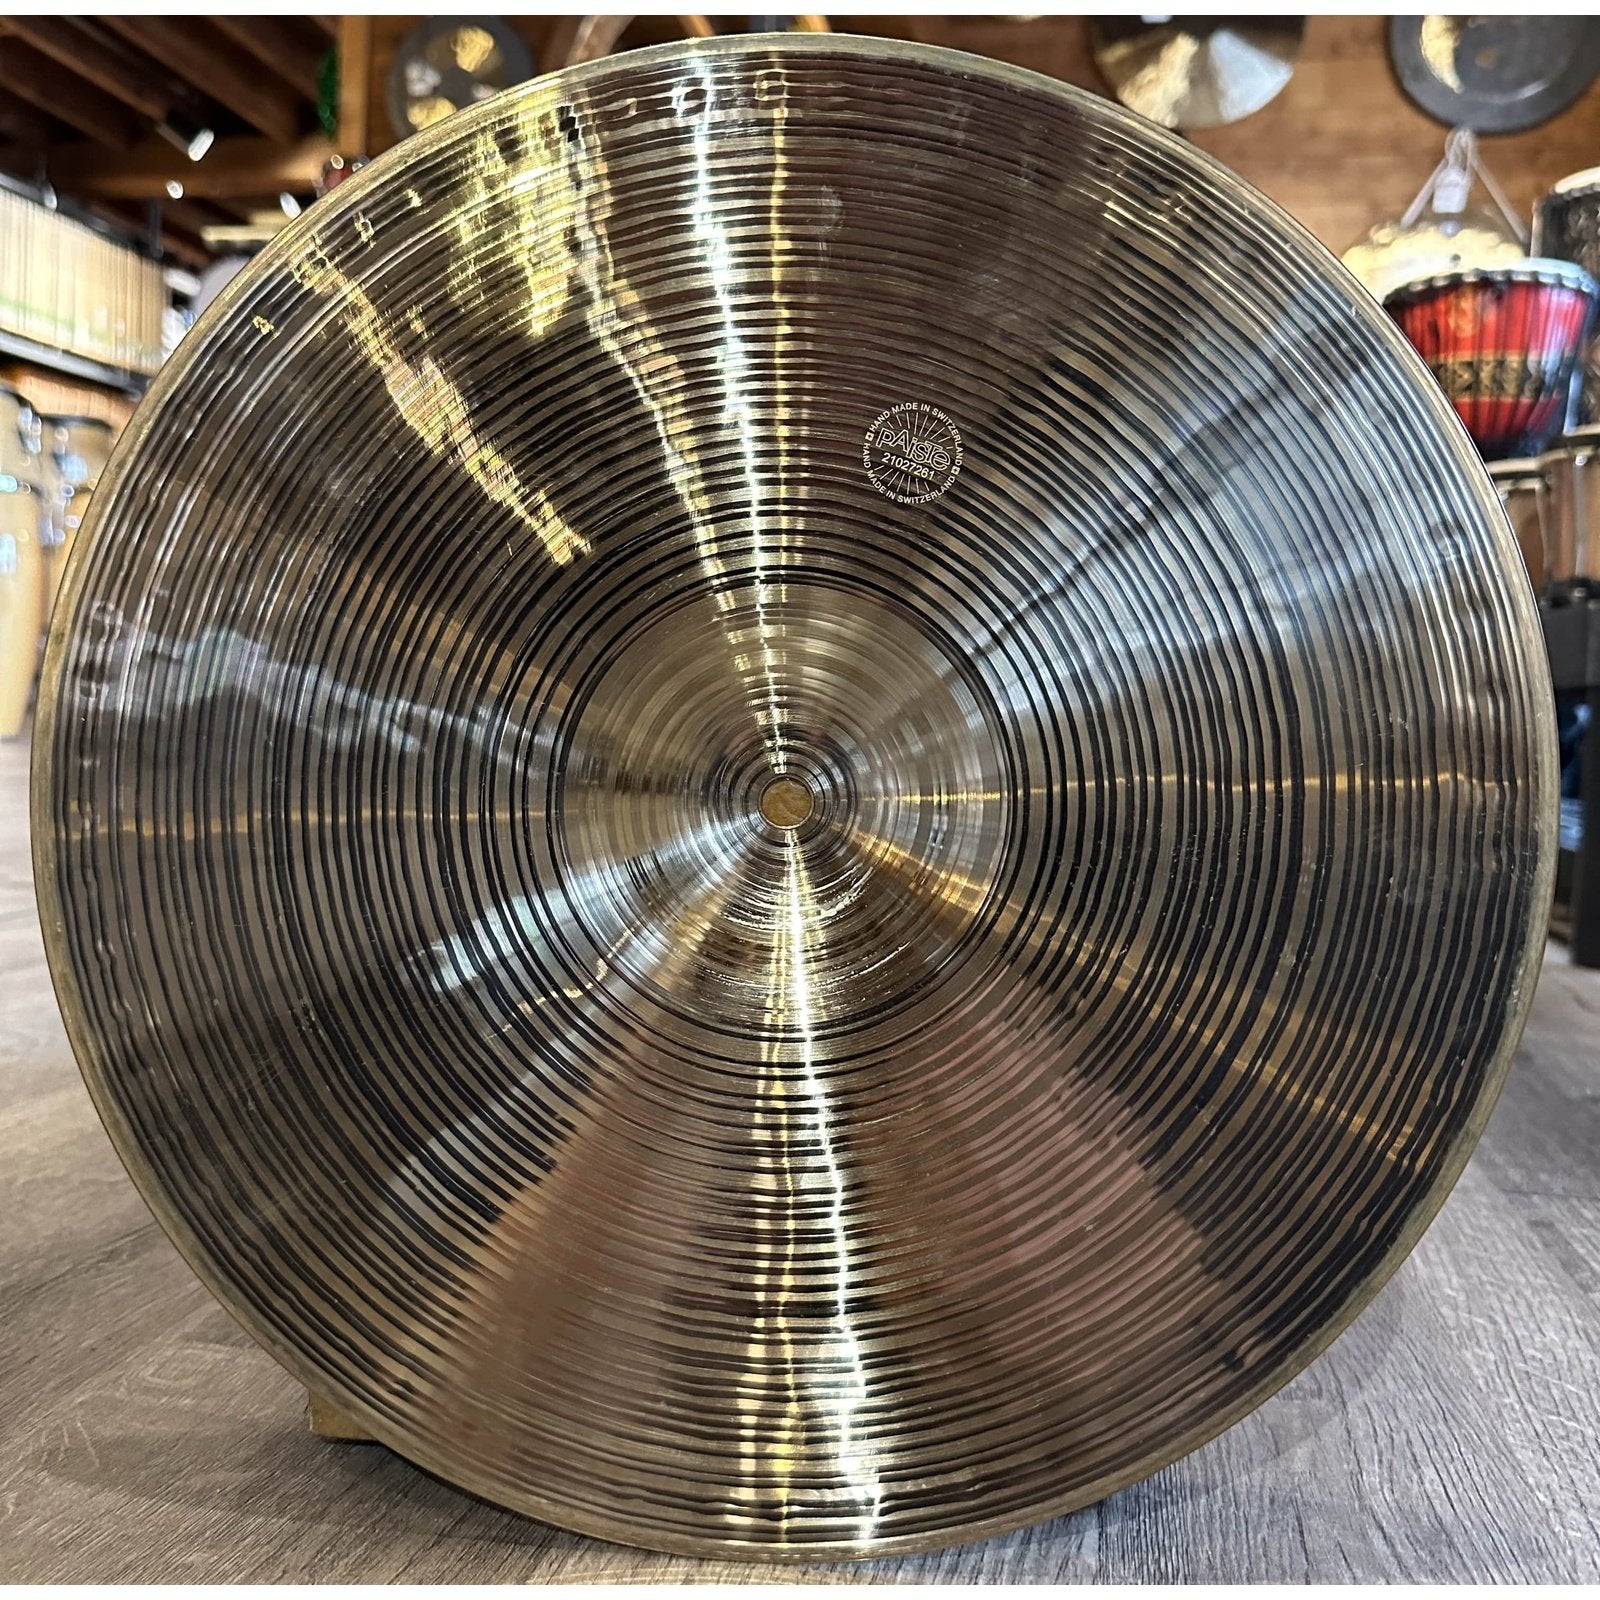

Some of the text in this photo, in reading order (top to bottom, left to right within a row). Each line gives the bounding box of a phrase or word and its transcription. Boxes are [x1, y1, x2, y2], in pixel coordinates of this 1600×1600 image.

[869, 403, 963, 466] HAND MADE IN SWITZERLAND
[863, 444, 955, 504] HAND MADE IN SWITZERLAND
[882, 452, 934, 480] 21027261
